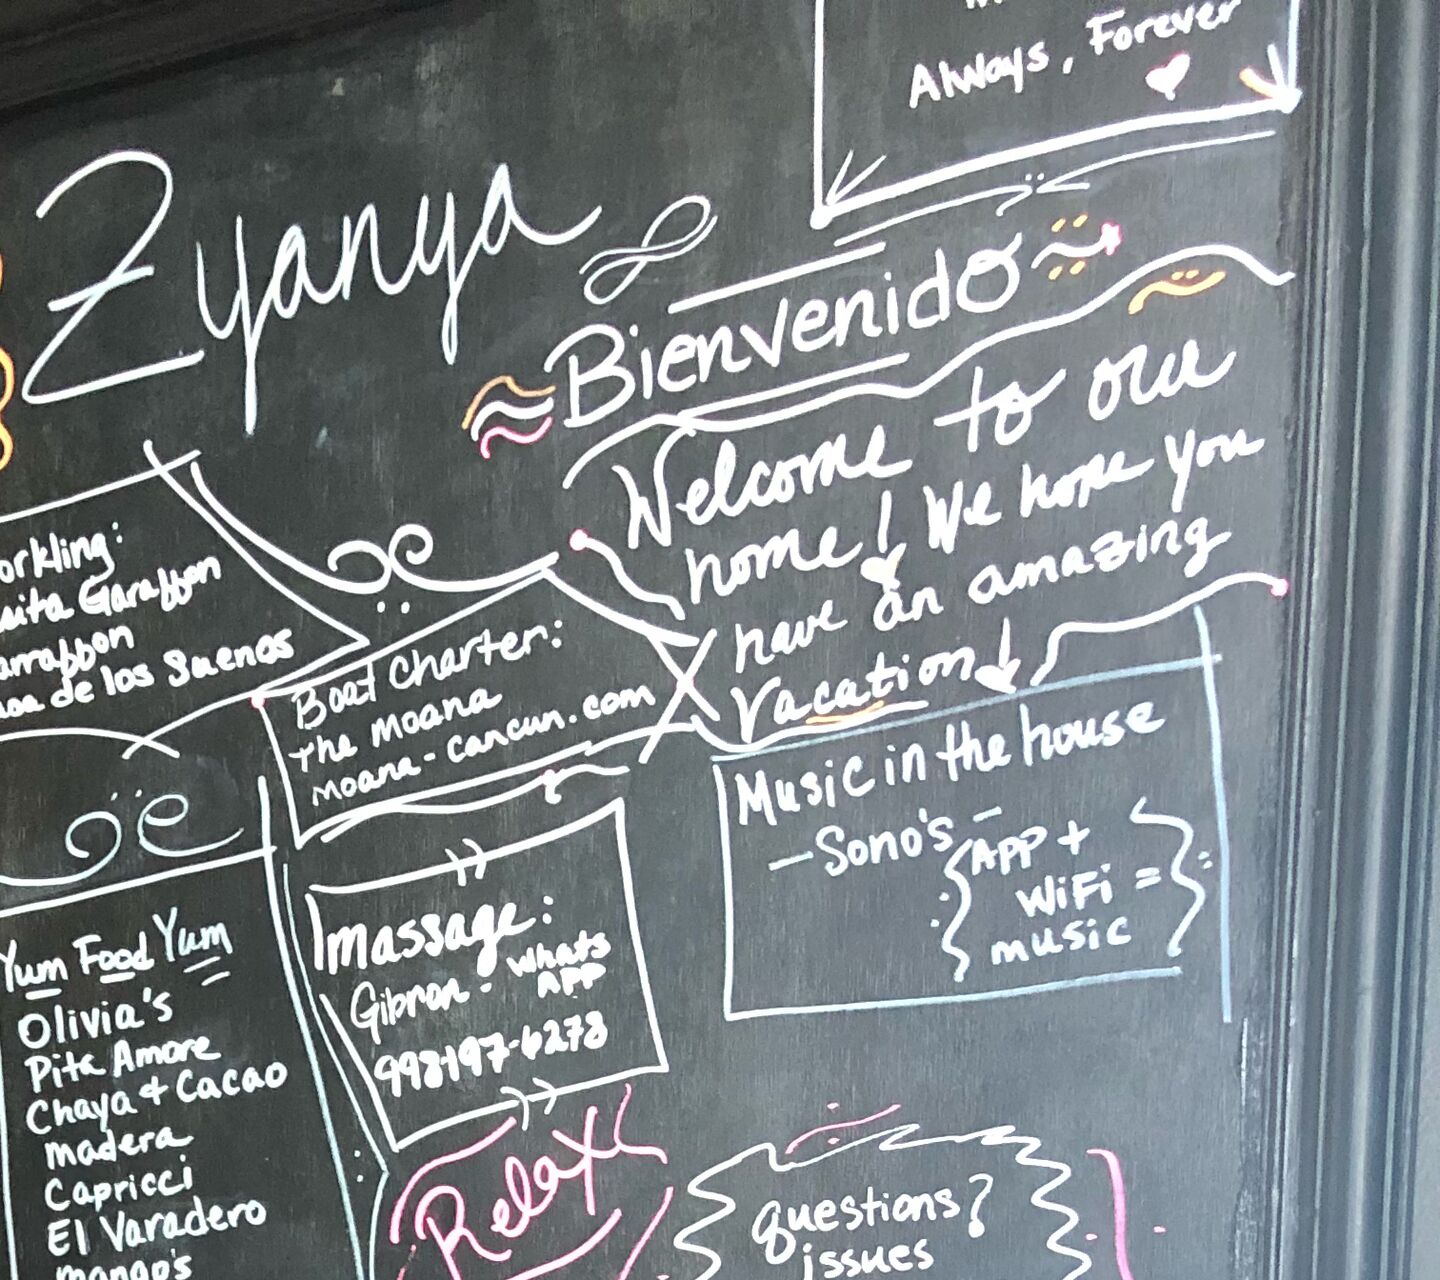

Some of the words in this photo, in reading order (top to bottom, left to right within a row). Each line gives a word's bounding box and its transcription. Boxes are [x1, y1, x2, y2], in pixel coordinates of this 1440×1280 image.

[1085, 0, 1242, 56] Forever
[22, 148, 603, 437] Zyanya
[543, 231, 1024, 430] Bienvenido
[612, 421, 913, 548] Welcome
[935, 363, 1071, 452] to
[1088, 338, 1237, 418] our
[922, 481, 1004, 555] We
[1020, 449, 1156, 531] hope
[733, 608, 847, 675] have
[874, 576, 943, 633] an
[967, 511, 1233, 601] amazing
[50, 675, 95, 707] de
[101, 663, 154, 695] los
[291, 662, 377, 729] Boat
[735, 756, 876, 826] Music
[885, 743, 925, 785] in
[935, 724, 1012, 781] the
[1020, 701, 1166, 766] house
[72, 930, 154, 977] Food
[153, 906, 233, 965] Yum
[991, 916, 1132, 965] music
[18, 986, 174, 1049] Olivia's
[113, 1033, 222, 1078] Amore
[26, 1091, 138, 1136] Chaya
[176, 1061, 287, 1103] Cacao
[45, 1153, 193, 1211] Capricci
[47, 1220, 88, 1256] El
[100, 1196, 268, 1252] Varadero
